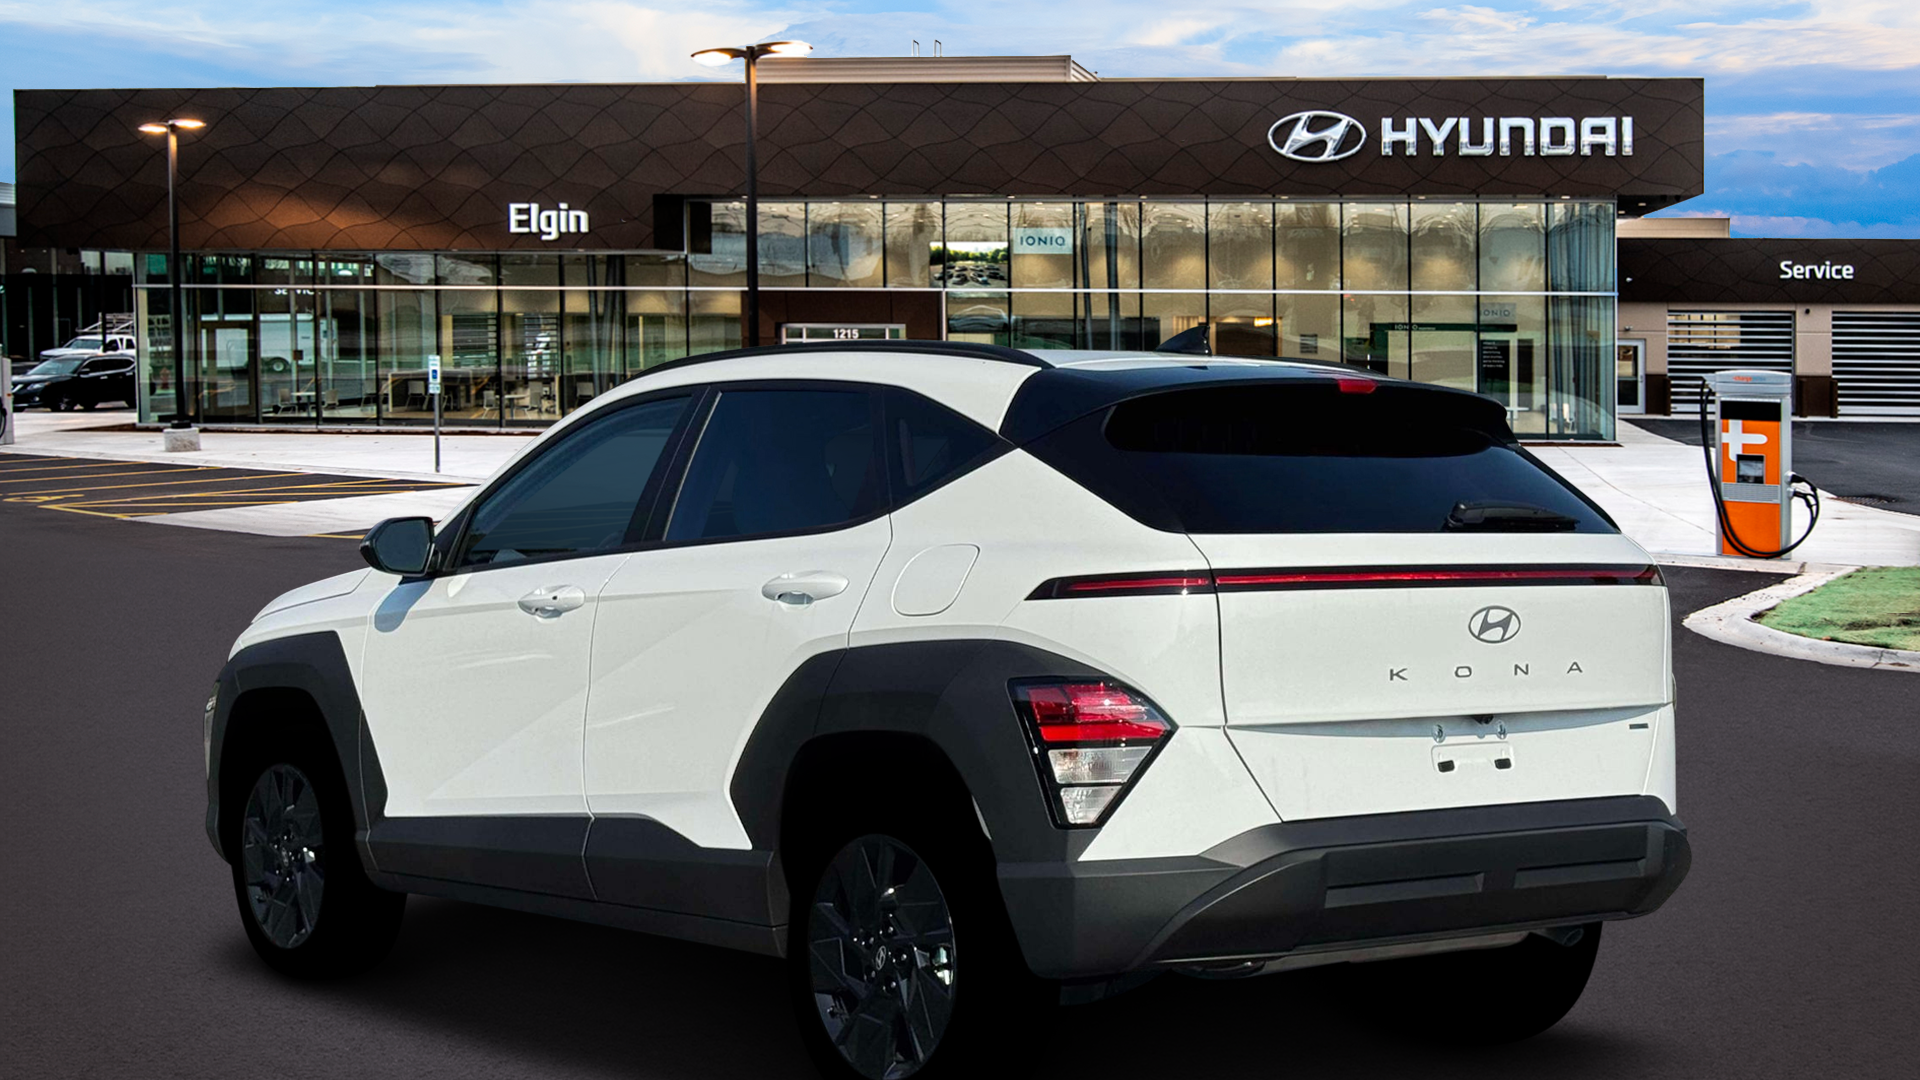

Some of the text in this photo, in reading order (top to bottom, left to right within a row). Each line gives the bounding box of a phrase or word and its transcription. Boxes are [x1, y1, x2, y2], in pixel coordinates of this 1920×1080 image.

[1381, 117, 1633, 156] HYUNDAI
[508, 203, 589, 240] Elgin
[1020, 236, 1065, 247] IONIQ
[1779, 260, 1854, 279] Service
[833, 329, 859, 339] 1215
[1394, 323, 1418, 331] IONQ
[1389, 661, 1583, 681] KONA
